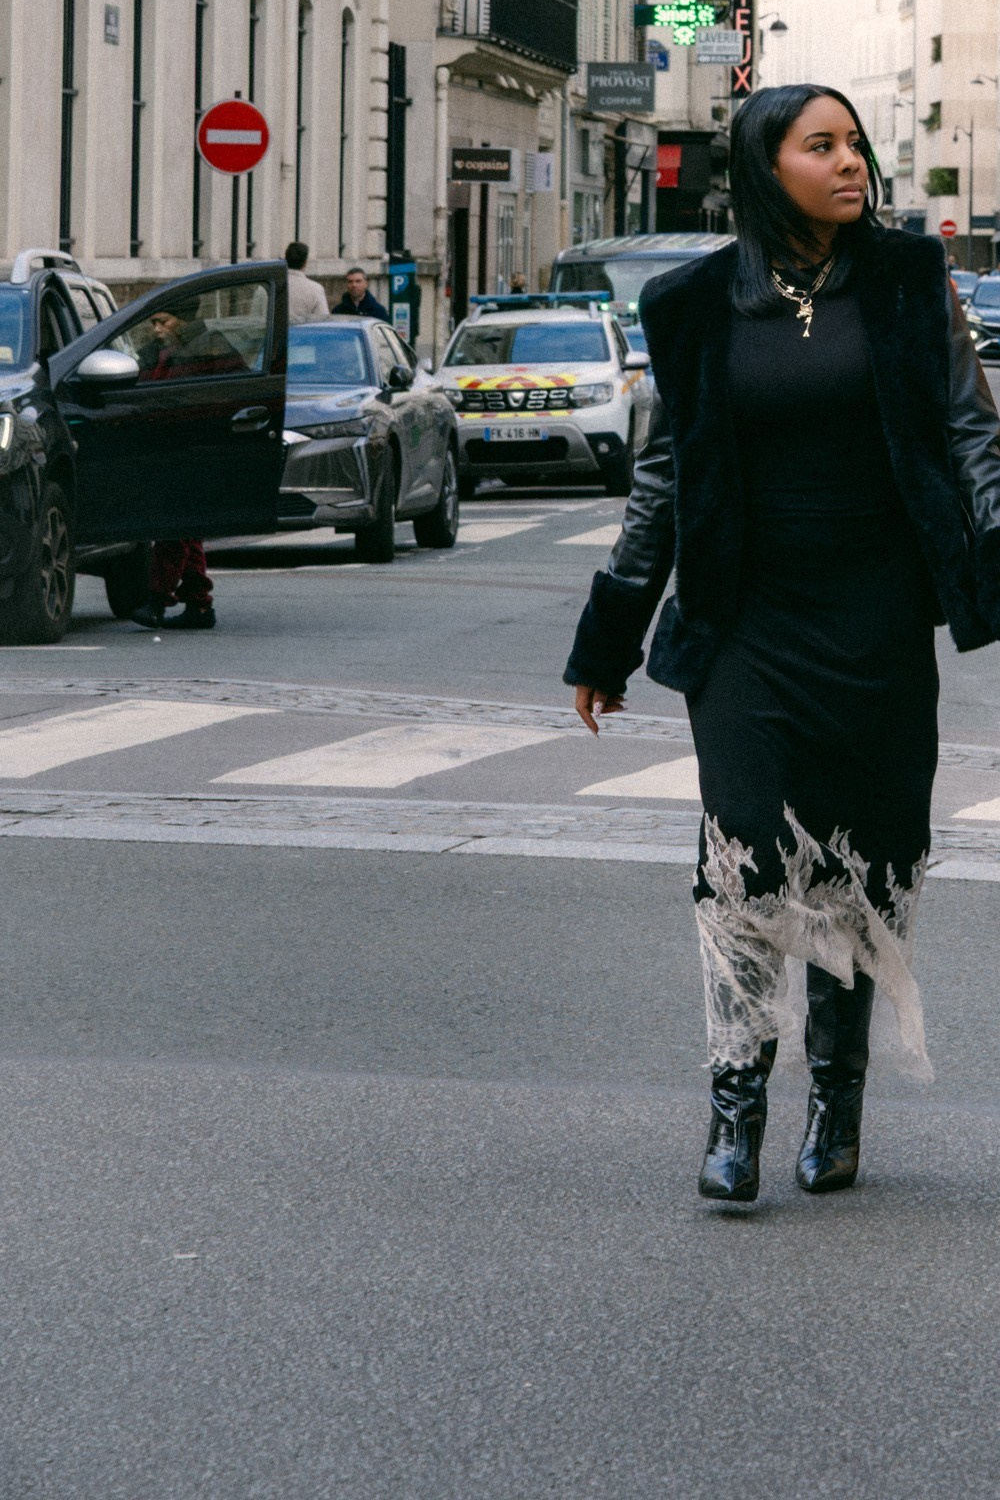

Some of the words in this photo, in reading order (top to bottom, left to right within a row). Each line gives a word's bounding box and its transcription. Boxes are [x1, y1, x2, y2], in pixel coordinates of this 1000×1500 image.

[699, 32, 740, 43] LAVERIE
[590, 75, 652, 88] PROVOST
[465, 160, 509, 171] copains
[393, 275, 405, 291] P
